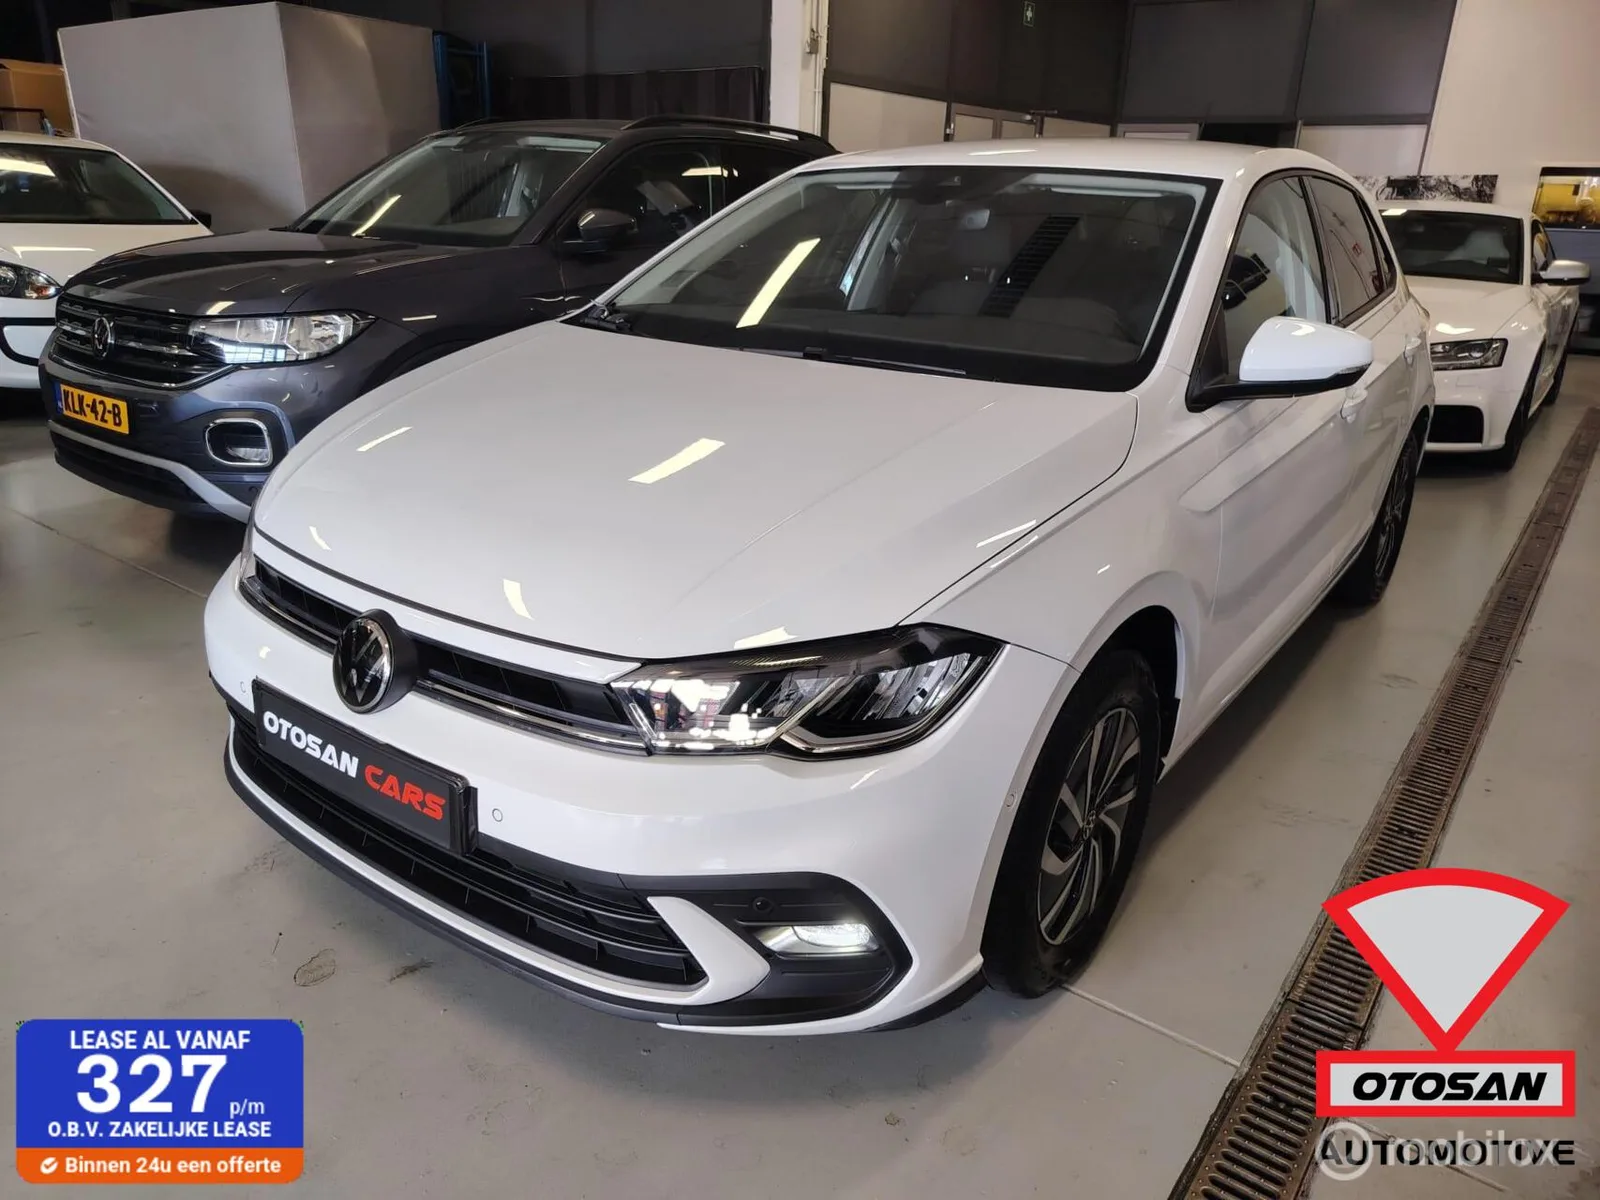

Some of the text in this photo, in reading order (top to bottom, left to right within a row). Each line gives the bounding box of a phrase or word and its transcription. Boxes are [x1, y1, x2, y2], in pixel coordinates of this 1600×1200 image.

[62, 388, 123, 427] KLK-42-B
[263, 710, 446, 821] OTOSAN CARS
